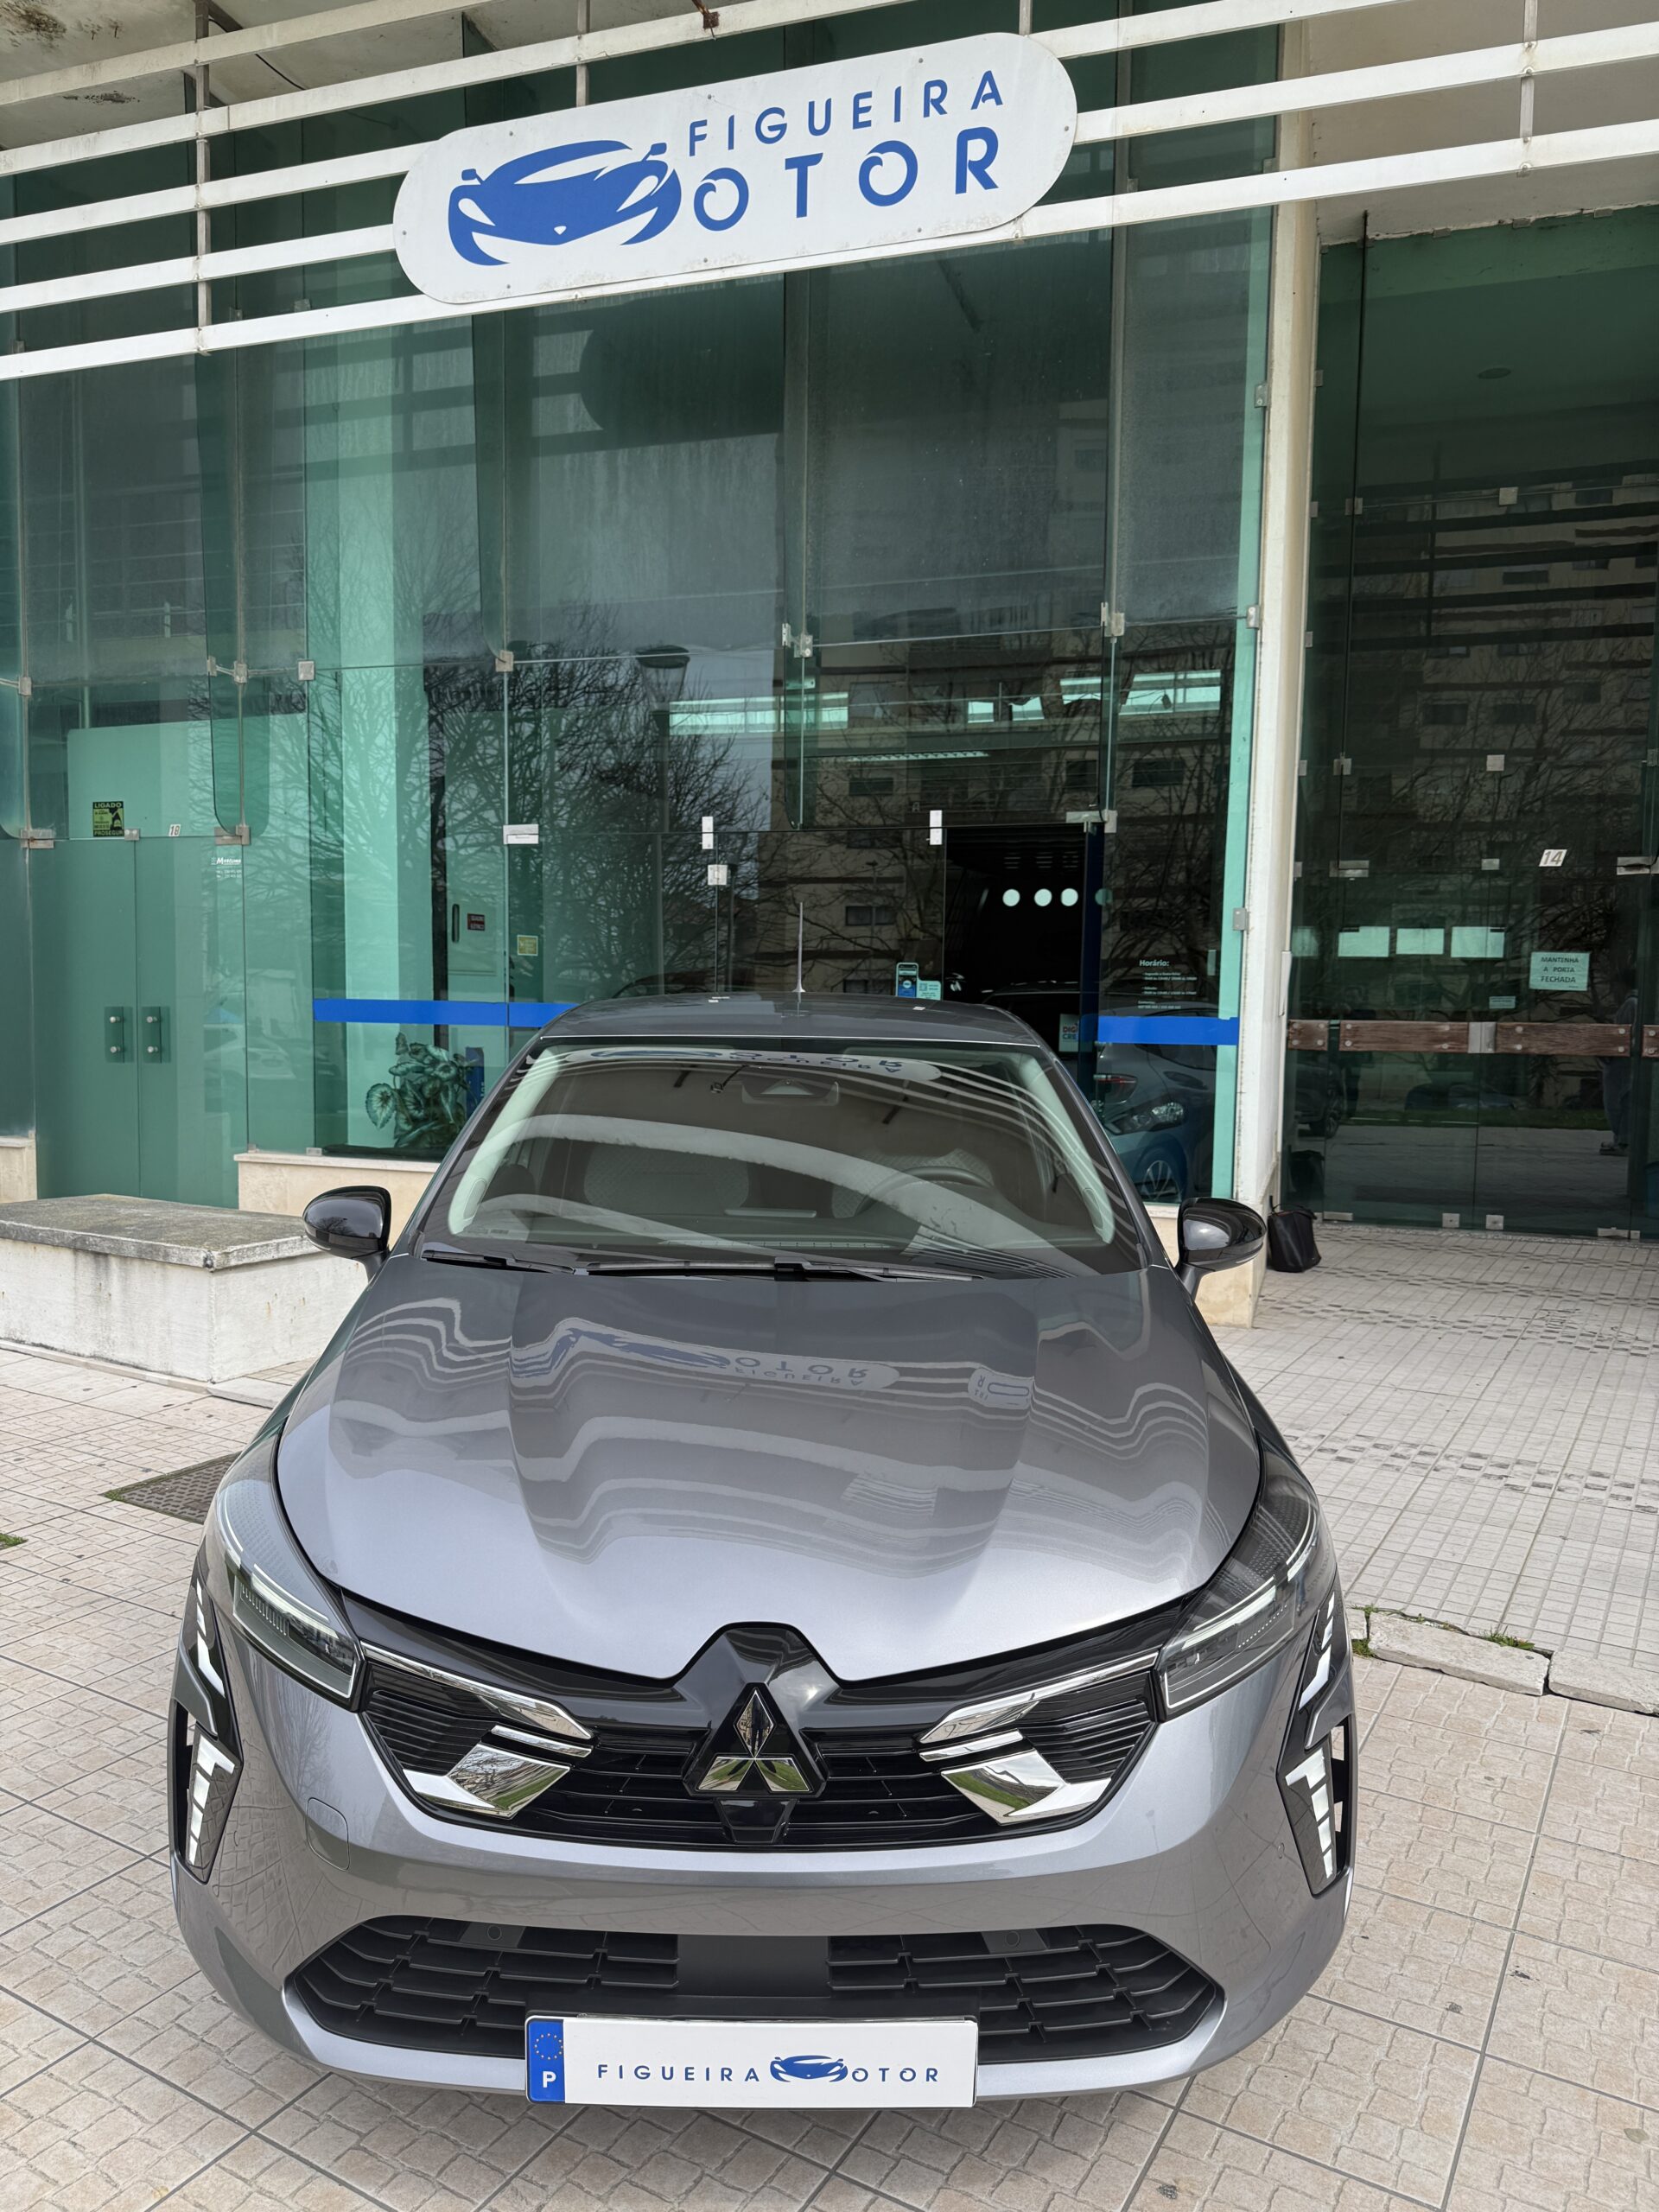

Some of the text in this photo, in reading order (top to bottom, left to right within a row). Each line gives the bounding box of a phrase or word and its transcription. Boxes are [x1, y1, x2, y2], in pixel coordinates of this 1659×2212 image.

[689, 71, 1002, 157] FIGUEIRA
[1544, 849, 1563, 865] 14
[543, 2070, 556, 2088] P
[598, 2064, 760, 2082] FIGUEIRA
